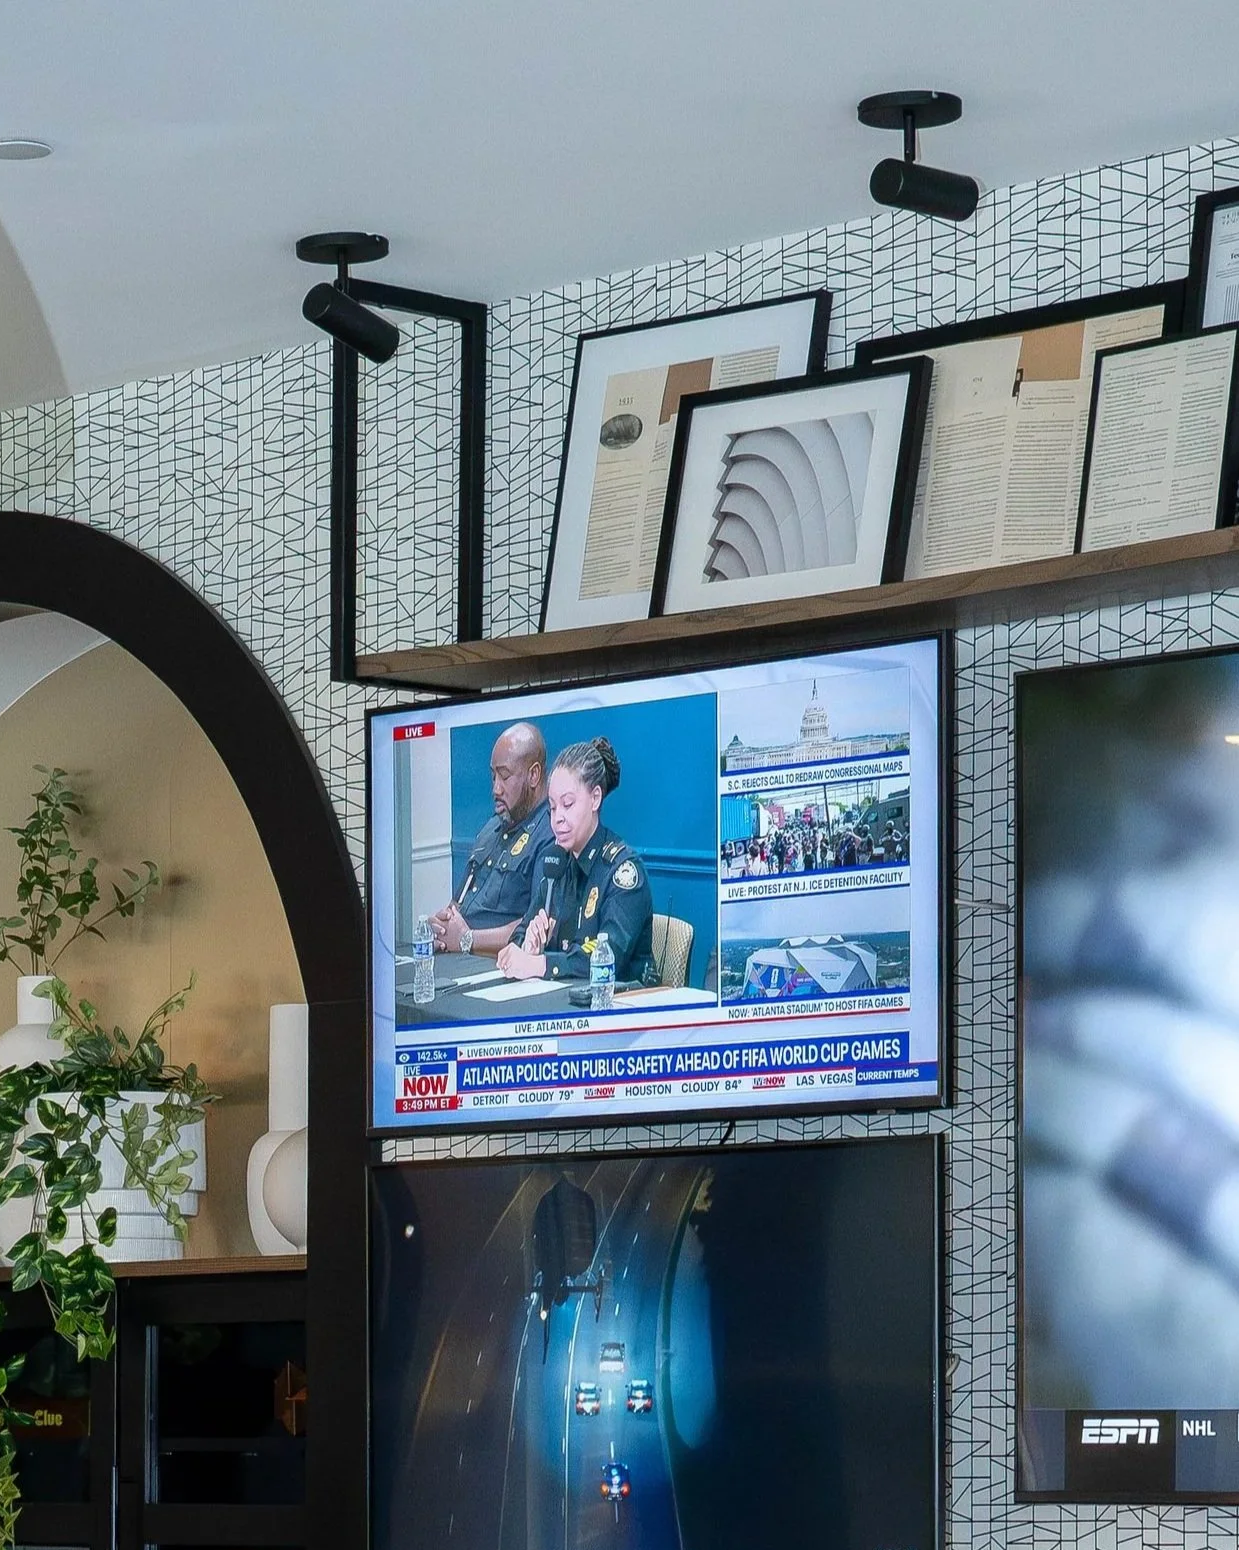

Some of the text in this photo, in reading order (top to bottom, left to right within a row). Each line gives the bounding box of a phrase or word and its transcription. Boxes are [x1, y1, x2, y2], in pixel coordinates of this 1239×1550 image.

[405, 727, 422, 738] LIVE
[728, 761, 903, 790] S.C. REJECTS CALL TO REDRAW CONGRESSIONAL MAPS
[728, 871, 903, 898] LIVE: PROTEST AT N.J. ICE DETENTION FACILITY
[728, 1008, 750, 1019] NOW:
[824, 1001, 835, 1012] TO
[836, 999, 856, 1010] HOST
[858, 998, 873, 1008] FIFA
[874, 996, 904, 1008] GAMES
[514, 1018, 590, 1034] LIVE: ATLANTA, GA
[417, 1050, 448, 1062] 142.5k+
[467, 1043, 544, 1058] LIVENOW FROM FOX
[462, 1038, 900, 1086] ATLANTA POLICE ON PUBLIC SAFETY AHEAD OF FIFA WORLD CUP GAMES
[404, 1065, 421, 1076] LIVE
[857, 1068, 920, 1082] CURRENT TEMPS
[404, 1075, 448, 1096] NOW
[472, 1094, 510, 1106] DETROIT
[518, 1092, 554, 1104] CLOUDY
[558, 1090, 574, 1101] 79°
[625, 1084, 672, 1096] HOUSTON
[681, 1081, 720, 1093] CLOUDY
[724, 1080, 742, 1091] 84°
[796, 1075, 814, 1086] LAS
[820, 1072, 853, 1084] VEGAS
[402, 1100, 424, 1111] 3:49
[424, 1099, 438, 1110] PM
[440, 1098, 450, 1108] ET
[34, 1410, 63, 1426] Clue
[1081, 1418, 1160, 1444] ESPN
[1182, 1420, 1216, 1436] NHL
